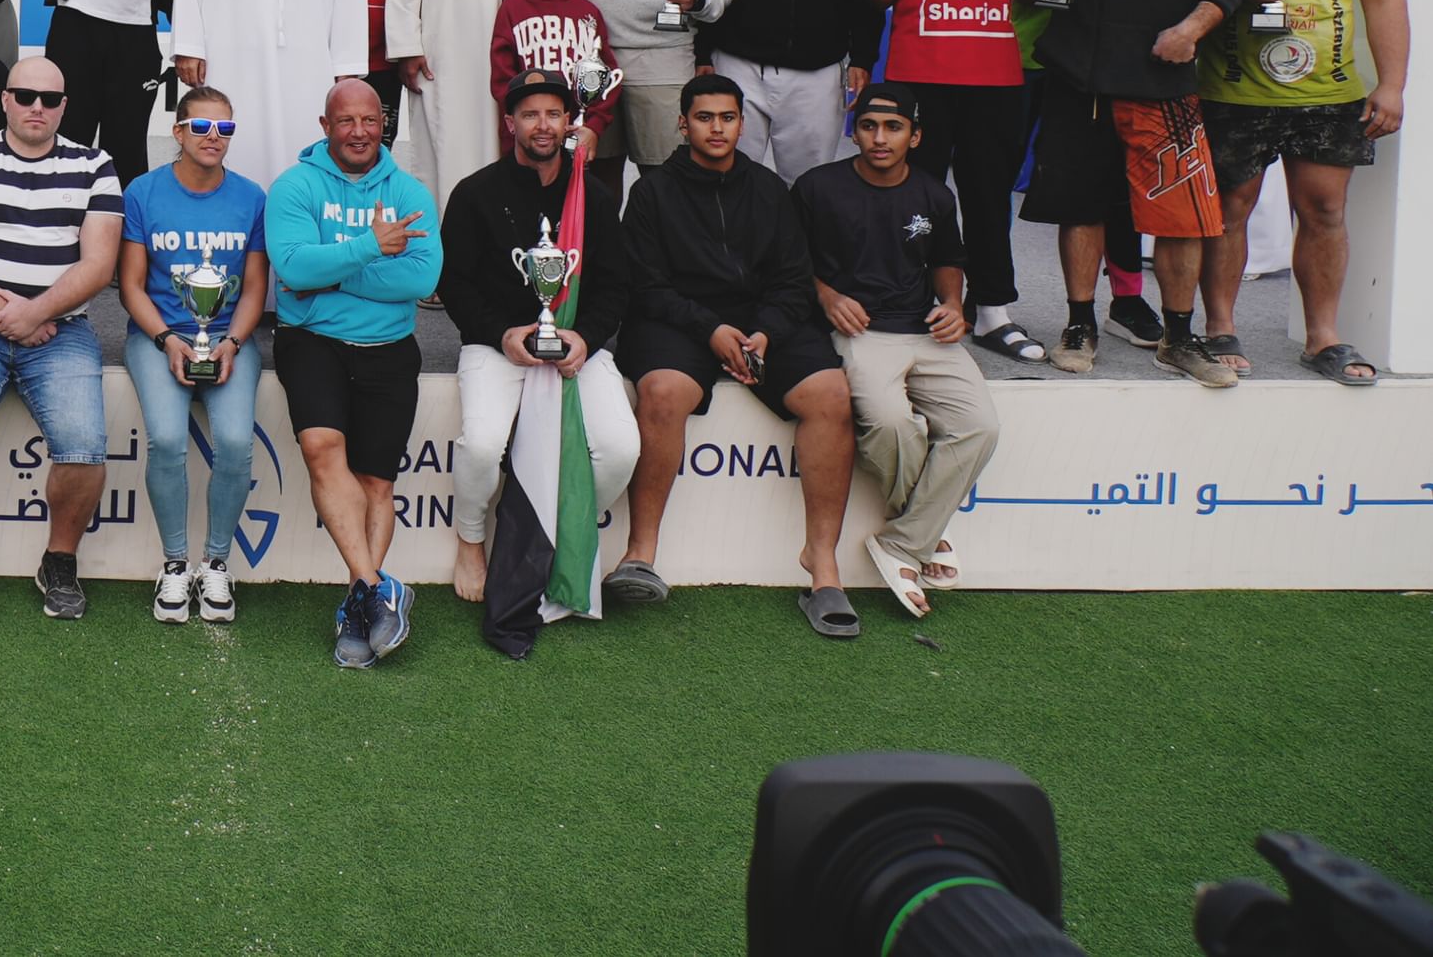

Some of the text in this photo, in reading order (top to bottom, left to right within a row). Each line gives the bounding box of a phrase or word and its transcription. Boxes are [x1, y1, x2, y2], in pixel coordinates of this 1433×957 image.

[513, 14, 602, 59] URBAN
[323, 201, 343, 221] NO
[152, 231, 246, 251] NO LIMIT
[1195, 474, 1324, 516] نحو
